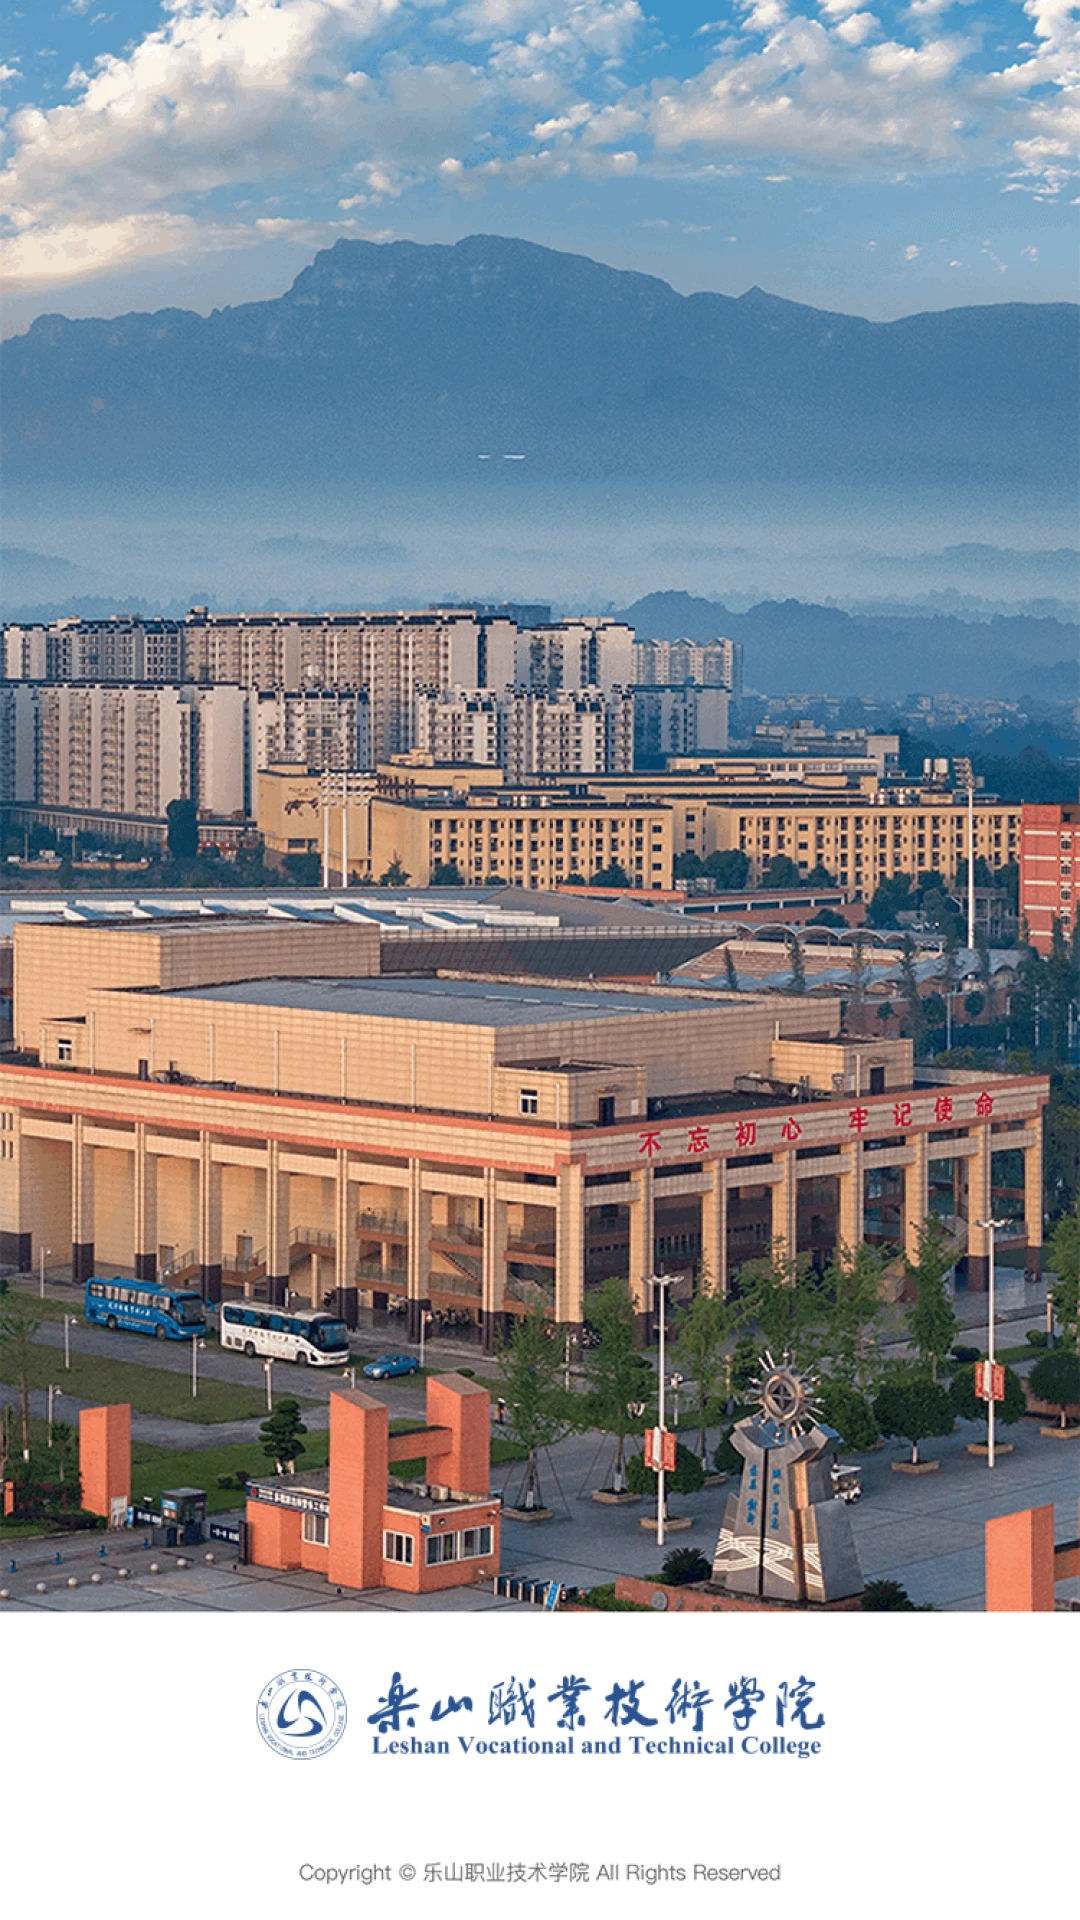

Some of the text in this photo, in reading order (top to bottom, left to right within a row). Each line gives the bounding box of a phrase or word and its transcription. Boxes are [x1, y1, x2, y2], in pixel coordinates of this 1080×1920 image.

[639, 1091, 995, 1158] 不忘初心 牢记使命
